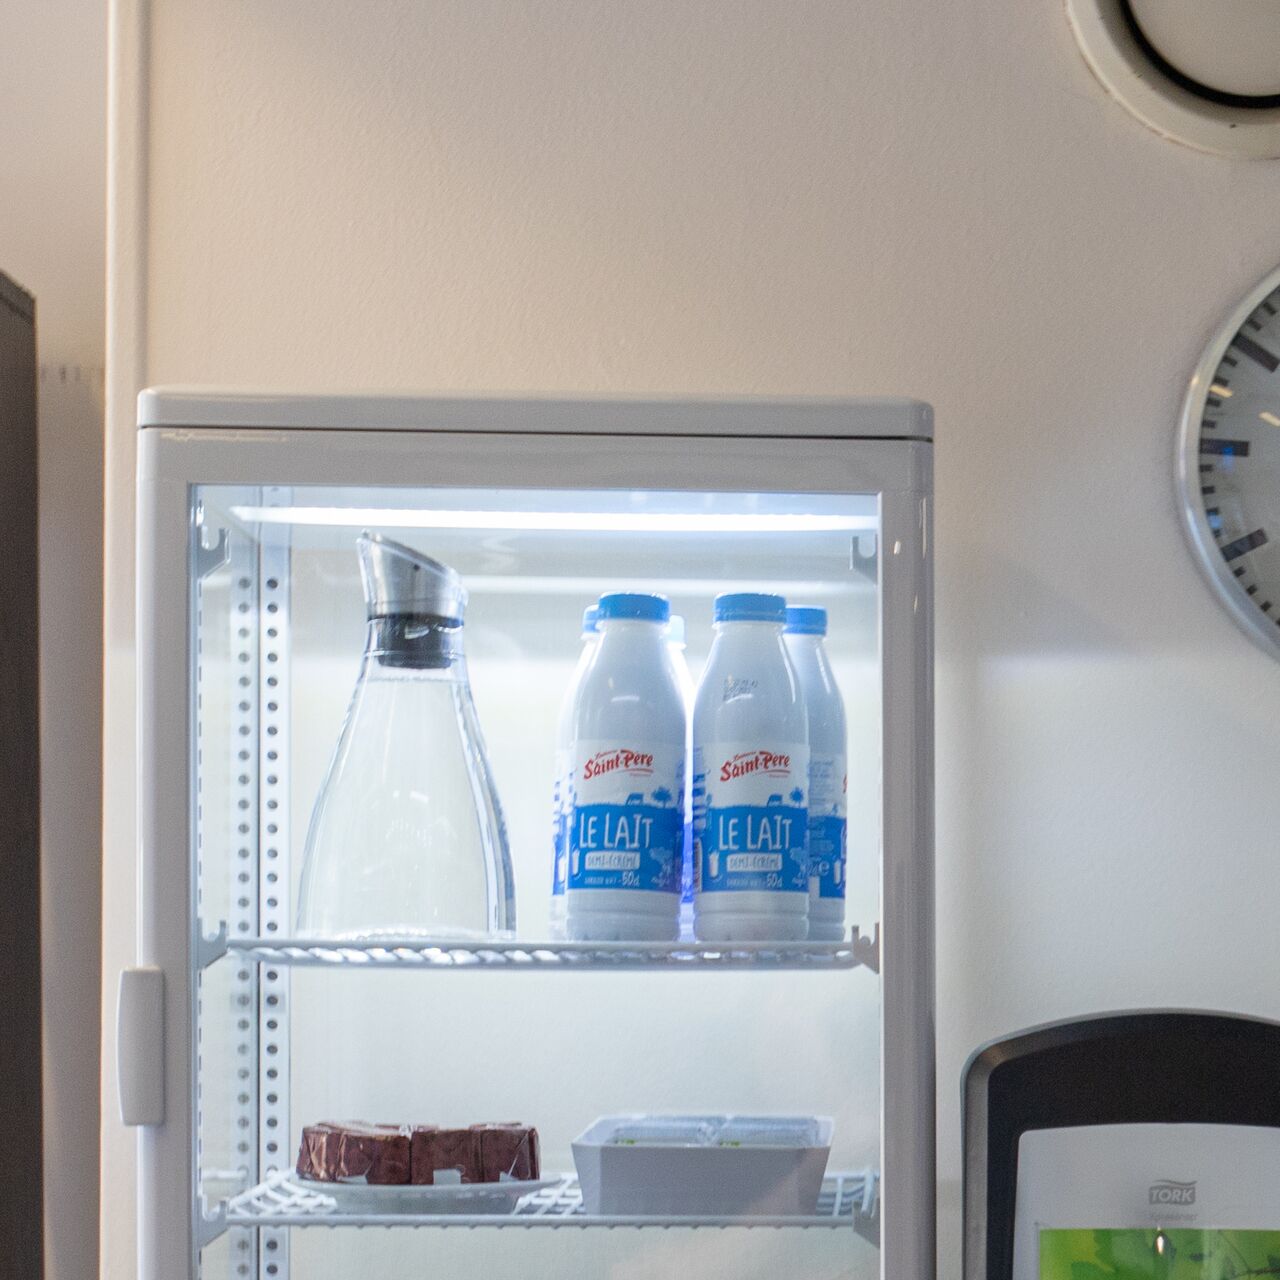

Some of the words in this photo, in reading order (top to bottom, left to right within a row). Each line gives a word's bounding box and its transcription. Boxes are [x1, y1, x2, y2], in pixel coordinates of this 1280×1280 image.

[579, 812, 598, 849] LE
[604, 812, 653, 849] LAIT
[719, 815, 740, 850] LE
[747, 814, 792, 850] LAIT
[1151, 1188, 1193, 1202] TORK
